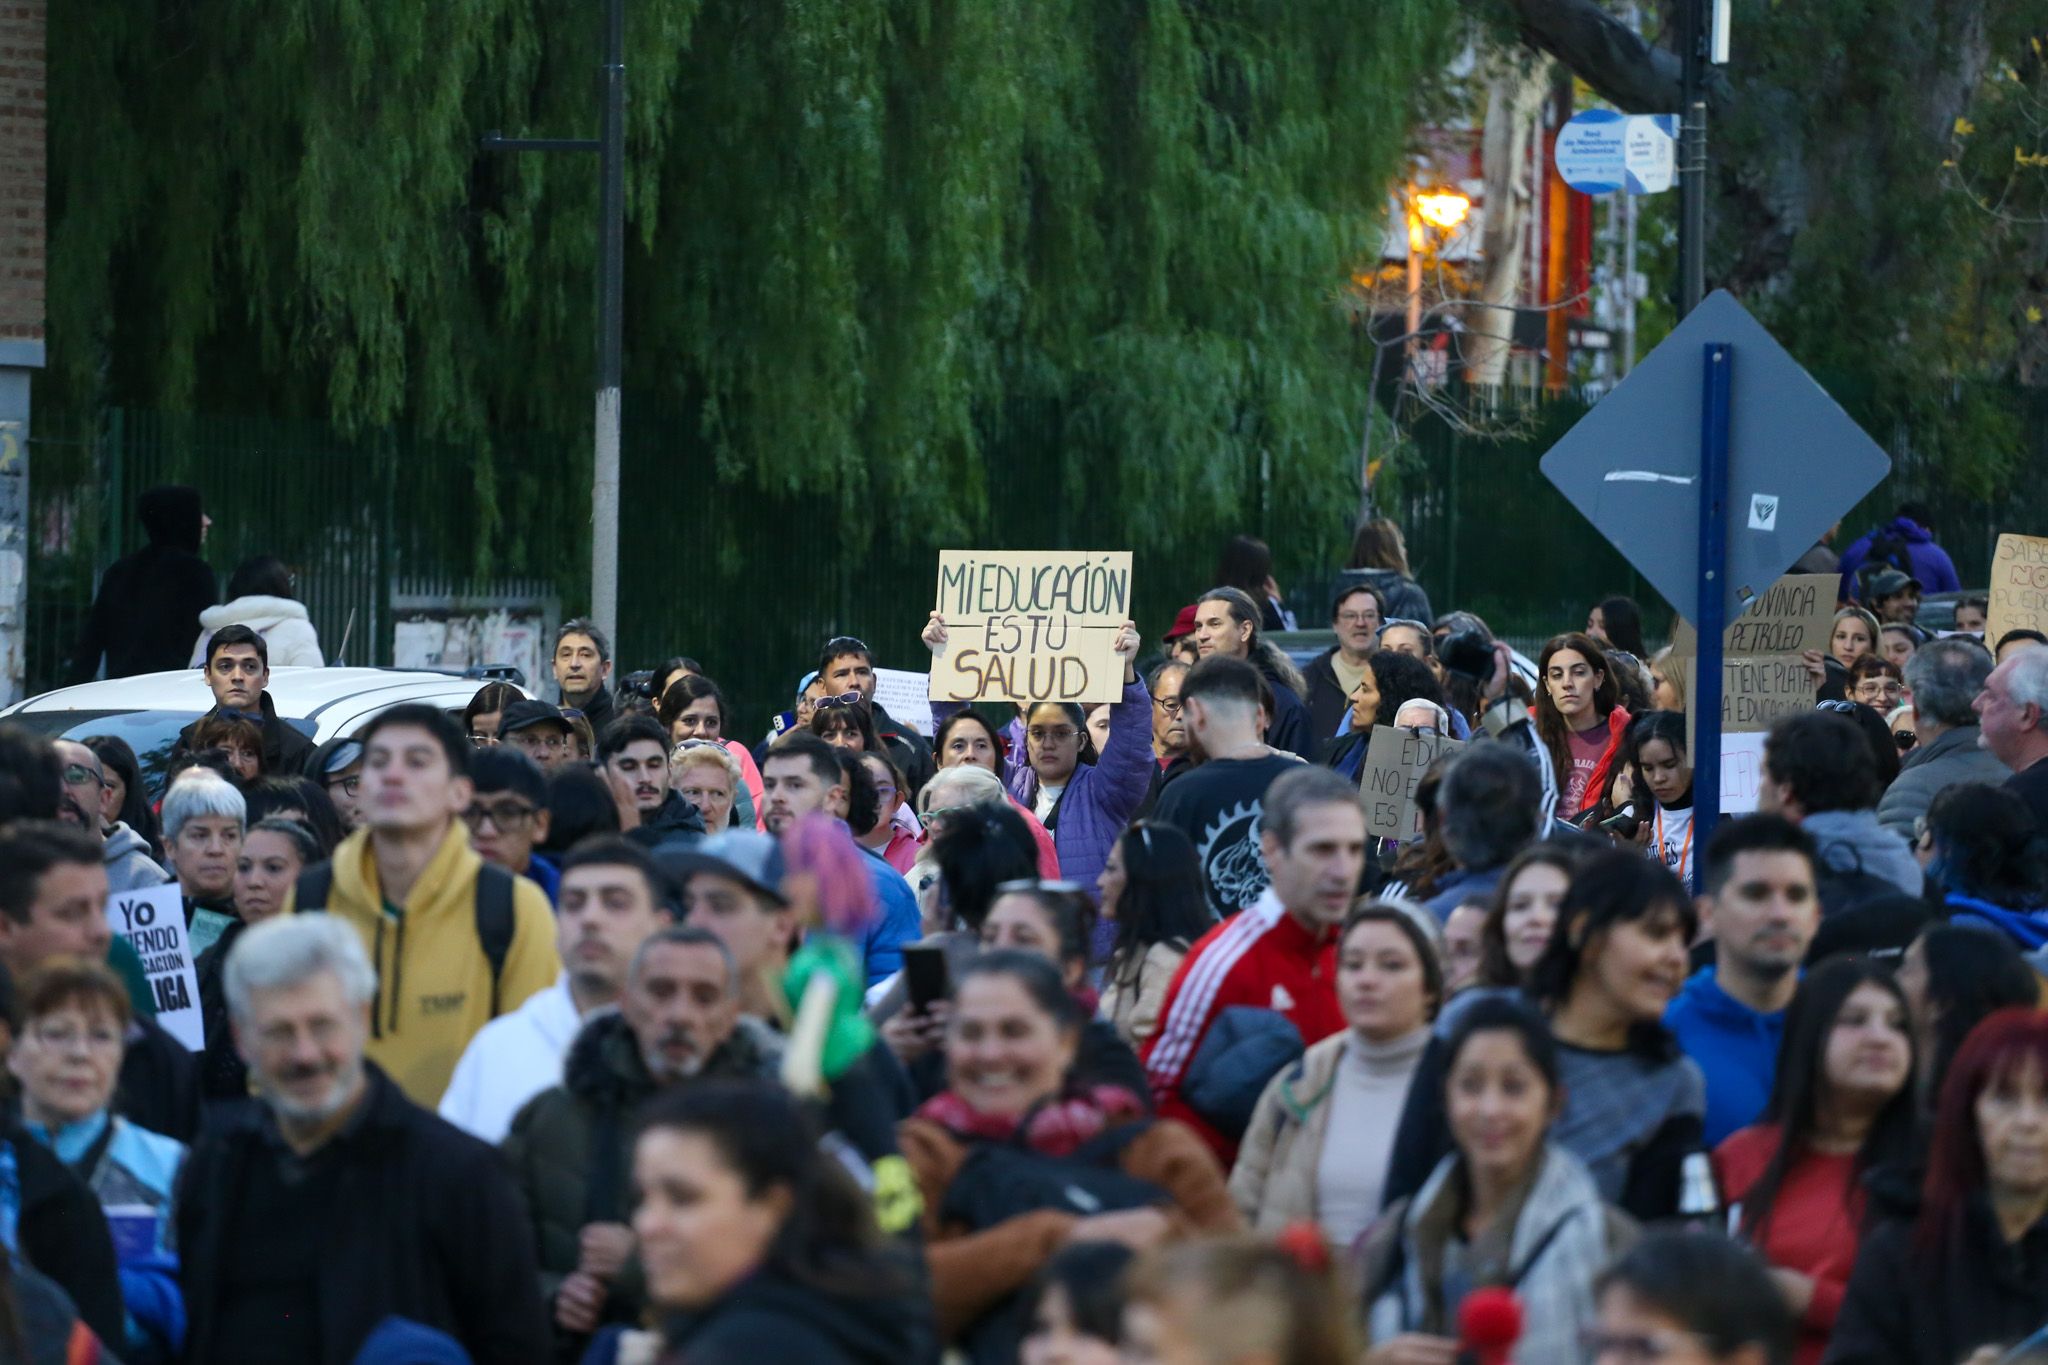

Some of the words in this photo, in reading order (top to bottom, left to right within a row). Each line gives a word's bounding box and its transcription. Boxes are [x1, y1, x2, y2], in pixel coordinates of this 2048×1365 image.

[2010, 564, 2048, 590] NO
[985, 615, 1022, 654] ES
[1027, 614, 1067, 654] TU
[1729, 621, 1804, 654] PETRÓLEO
[948, 649, 1089, 701] SALUD
[1774, 661, 1812, 694] PLATA
[1371, 767, 1400, 796] NO
[1374, 802, 1398, 828] ES
